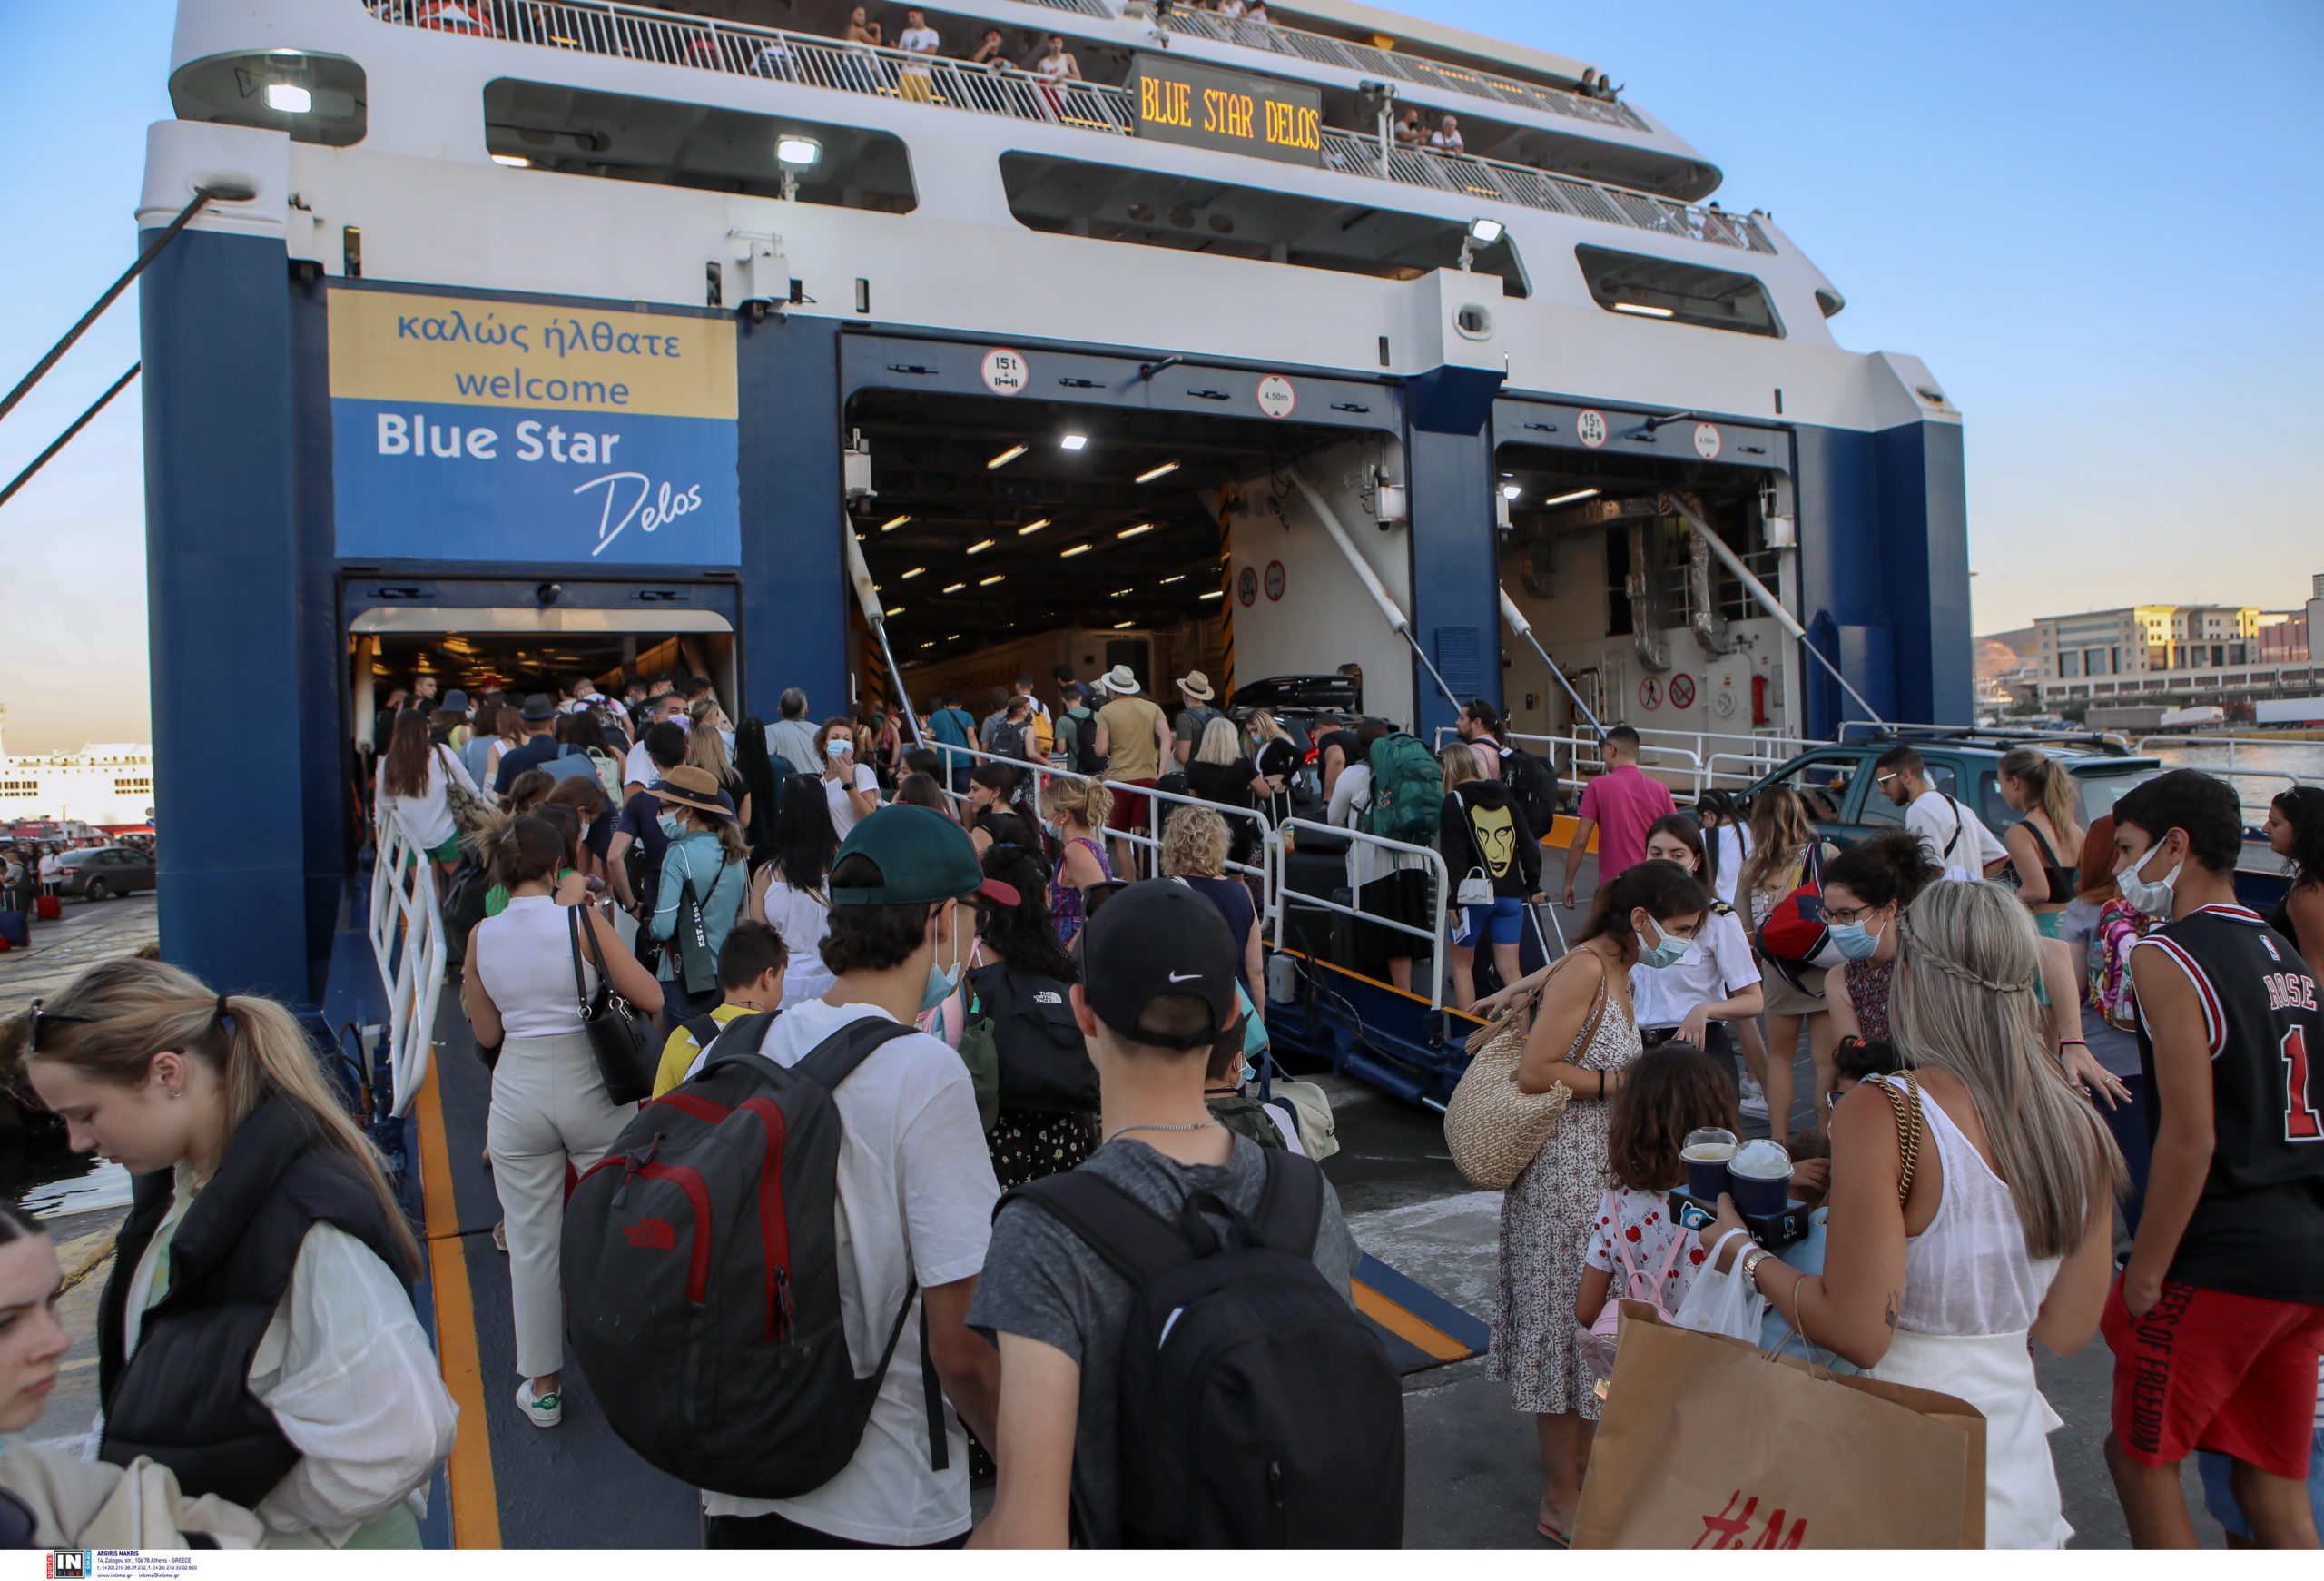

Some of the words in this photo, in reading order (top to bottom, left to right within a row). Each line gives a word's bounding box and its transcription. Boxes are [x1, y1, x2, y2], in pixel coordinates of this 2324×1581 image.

[1140, 76, 1192, 127] BLUE
[1204, 88, 1254, 139] STAR
[1265, 100, 1320, 151] DELOS
[397, 311, 529, 352] καλώς
[544, 317, 681, 358] ήλθατε
[455, 368, 629, 405] welcome
[1265, 391, 1289, 401] 4.50m
[377, 413, 498, 459] Blue
[516, 420, 620, 465] Star
[574, 471, 703, 557] Delos
[2263, 973, 2318, 1012] ROSE
[2280, 1024, 2324, 1141] 1
[2136, 1325, 2174, 1356] OF
[2130, 1355, 2171, 1453] FREEDOM
